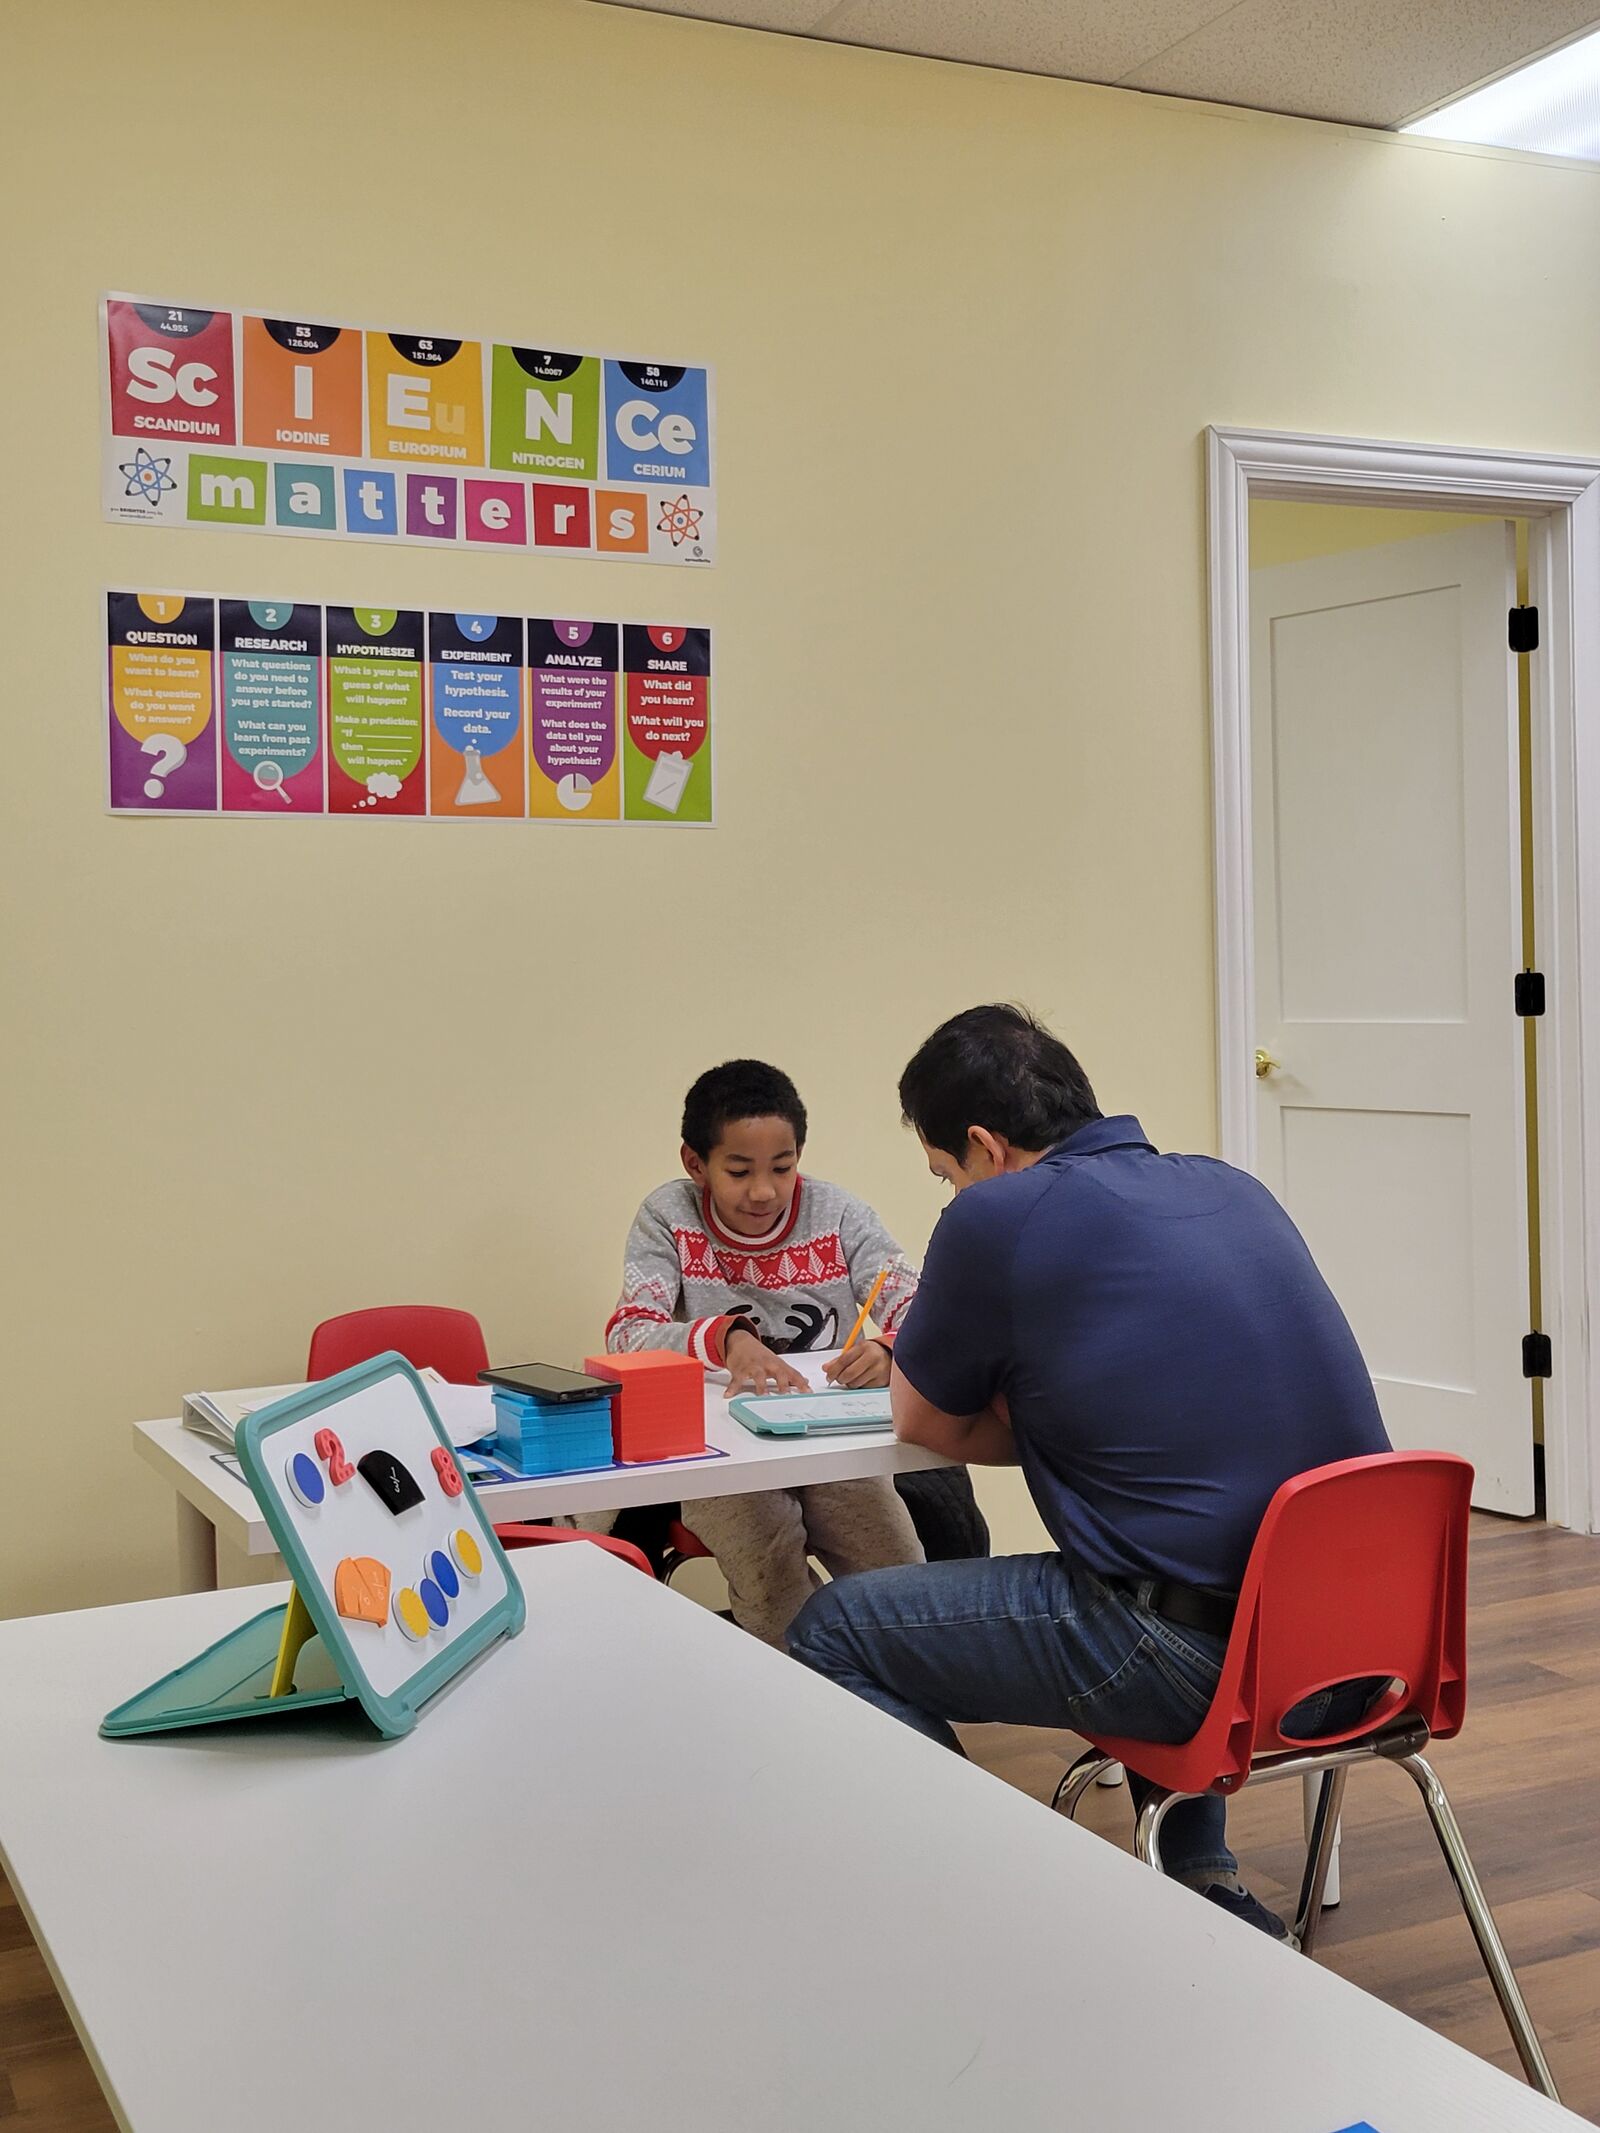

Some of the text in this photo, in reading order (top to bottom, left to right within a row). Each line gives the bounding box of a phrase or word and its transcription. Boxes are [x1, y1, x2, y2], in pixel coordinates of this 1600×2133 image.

[168, 311, 183, 321] 21
[296, 326, 311, 338] 53
[419, 340, 433, 350] 63
[544, 356, 551, 365] 7
[646, 367, 660, 377] 58
[126, 347, 219, 407] Sc
[295, 365, 313, 420] I
[525, 388, 573, 444] N
[615, 399, 696, 455] Ce
[134, 416, 220, 436] SCANDIUM
[276, 429, 330, 446] IODINE
[389, 440, 466, 459] EUROPIUM
[512, 452, 584, 470] NITROGEN
[633, 463, 686, 478] CERIUM
[157, 602, 165, 616] 1
[265, 608, 277, 622] 2
[371, 614, 381, 629] 3
[471, 621, 482, 634] 4
[126, 631, 198, 645] QUESTION
[569, 627, 579, 640] 5
[662, 632, 672, 645] 6
[235, 637, 307, 651] RESEARCH
[337, 644, 415, 658] HYPOTHESIZE
[441, 650, 512, 663] EXPERIMENT
[128, 653, 195, 665] What do you
[232, 658, 311, 671] What questions
[545, 654, 602, 667] ANALYZE
[334, 665, 418, 678] What is your best
[647, 660, 688, 671] SHARE
[125, 667, 199, 678] want to learn?
[234, 672, 309, 684] do you need to
[451, 670, 503, 683] Test your
[540, 674, 607, 685] What were the
[643, 680, 692, 691] What did
[236, 685, 307, 696] answer before
[343, 681, 410, 691] guess of what
[445, 685, 509, 697] hypothesis.
[124, 687, 201, 700] What question
[541, 687, 606, 698] results of your
[231, 698, 312, 709] you get started?
[346, 695, 407, 705] will happen?
[546, 699, 602, 709] experiment?
[640, 695, 694, 706] you learn?
[130, 701, 195, 712] do you want
[335, 715, 360, 724] Make
[444, 707, 511, 720] Record your
[134, 715, 193, 725] to answer?
[238, 720, 306, 732] What can you
[541, 719, 607, 730] What does the
[631, 715, 704, 729] What will you
[463, 723, 492, 734] data.
[234, 733, 311, 745] learn from past
[546, 732, 602, 742] data tell you
[645, 731, 691, 742] do next?
[238, 746, 306, 757] experiments?
[341, 742, 363, 751] then
[550, 744, 599, 754] about your
[347, 756, 365, 765] will
[547, 755, 601, 766] hypothesis?
[314, 1428, 356, 1487] 2
[430, 1445, 464, 1497] 8
